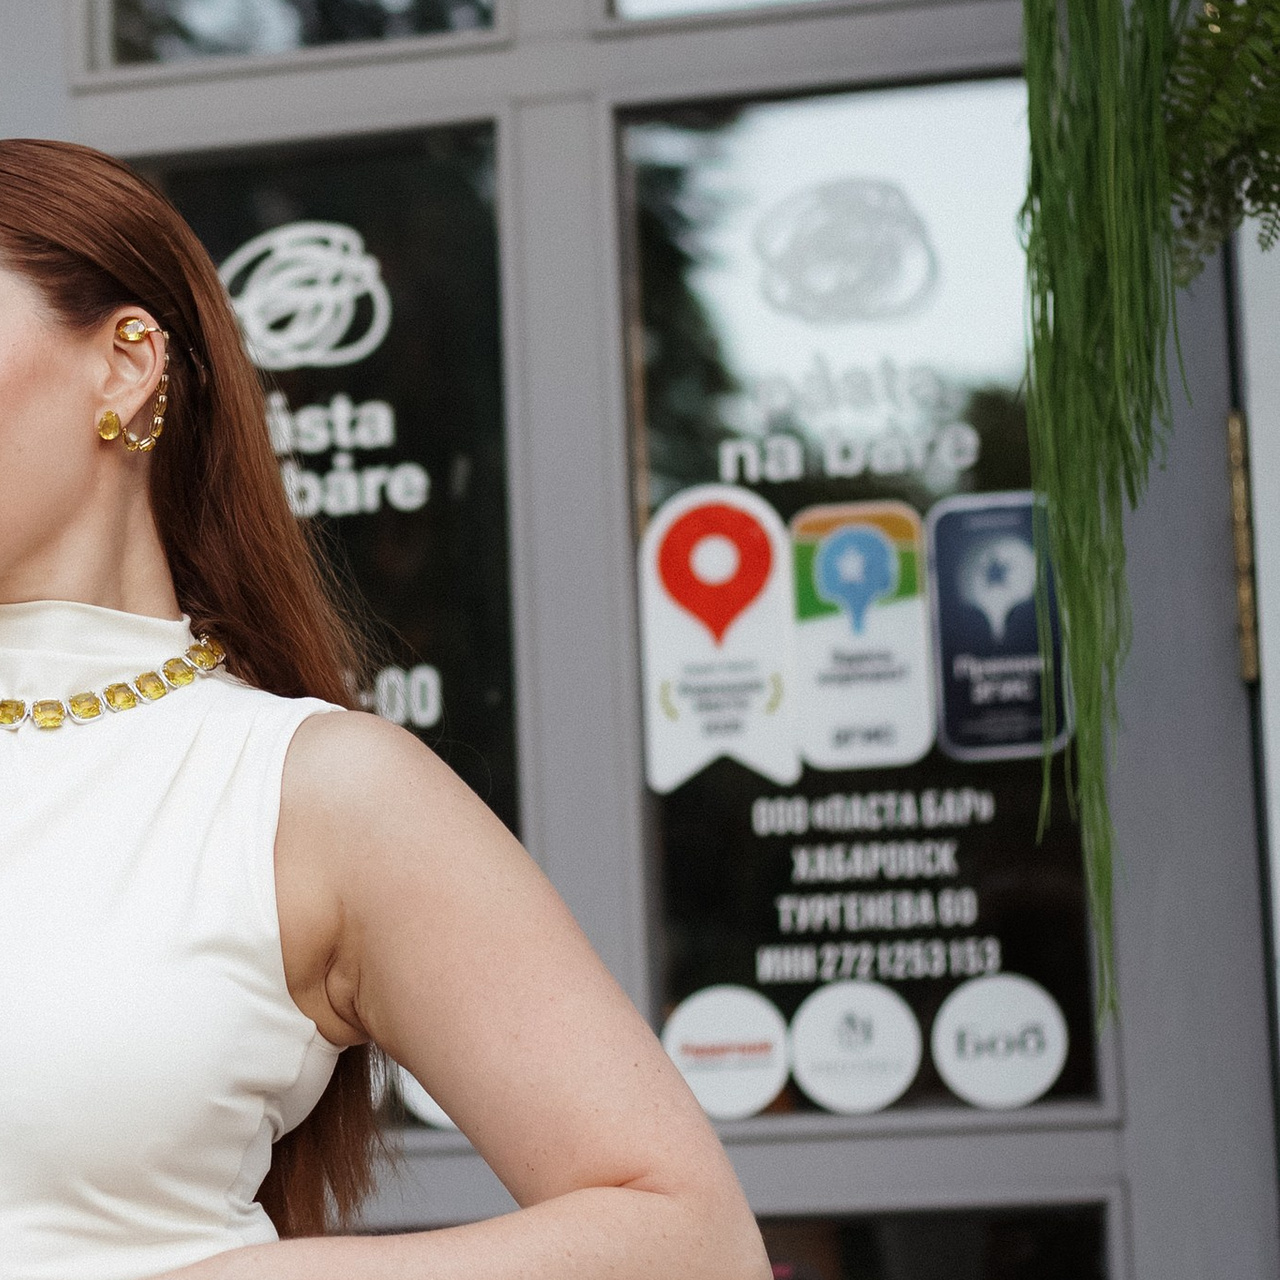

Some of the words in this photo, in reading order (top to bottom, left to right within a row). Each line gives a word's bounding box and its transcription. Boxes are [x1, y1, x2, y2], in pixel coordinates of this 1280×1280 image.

[720, 434, 804, 483] na
[752, 797, 808, 836] ООО
[792, 839, 959, 883] ХАБАРОВСК
[776, 892, 936, 933] ТУРГЕНЕВА
[756, 943, 818, 984] ИНН
